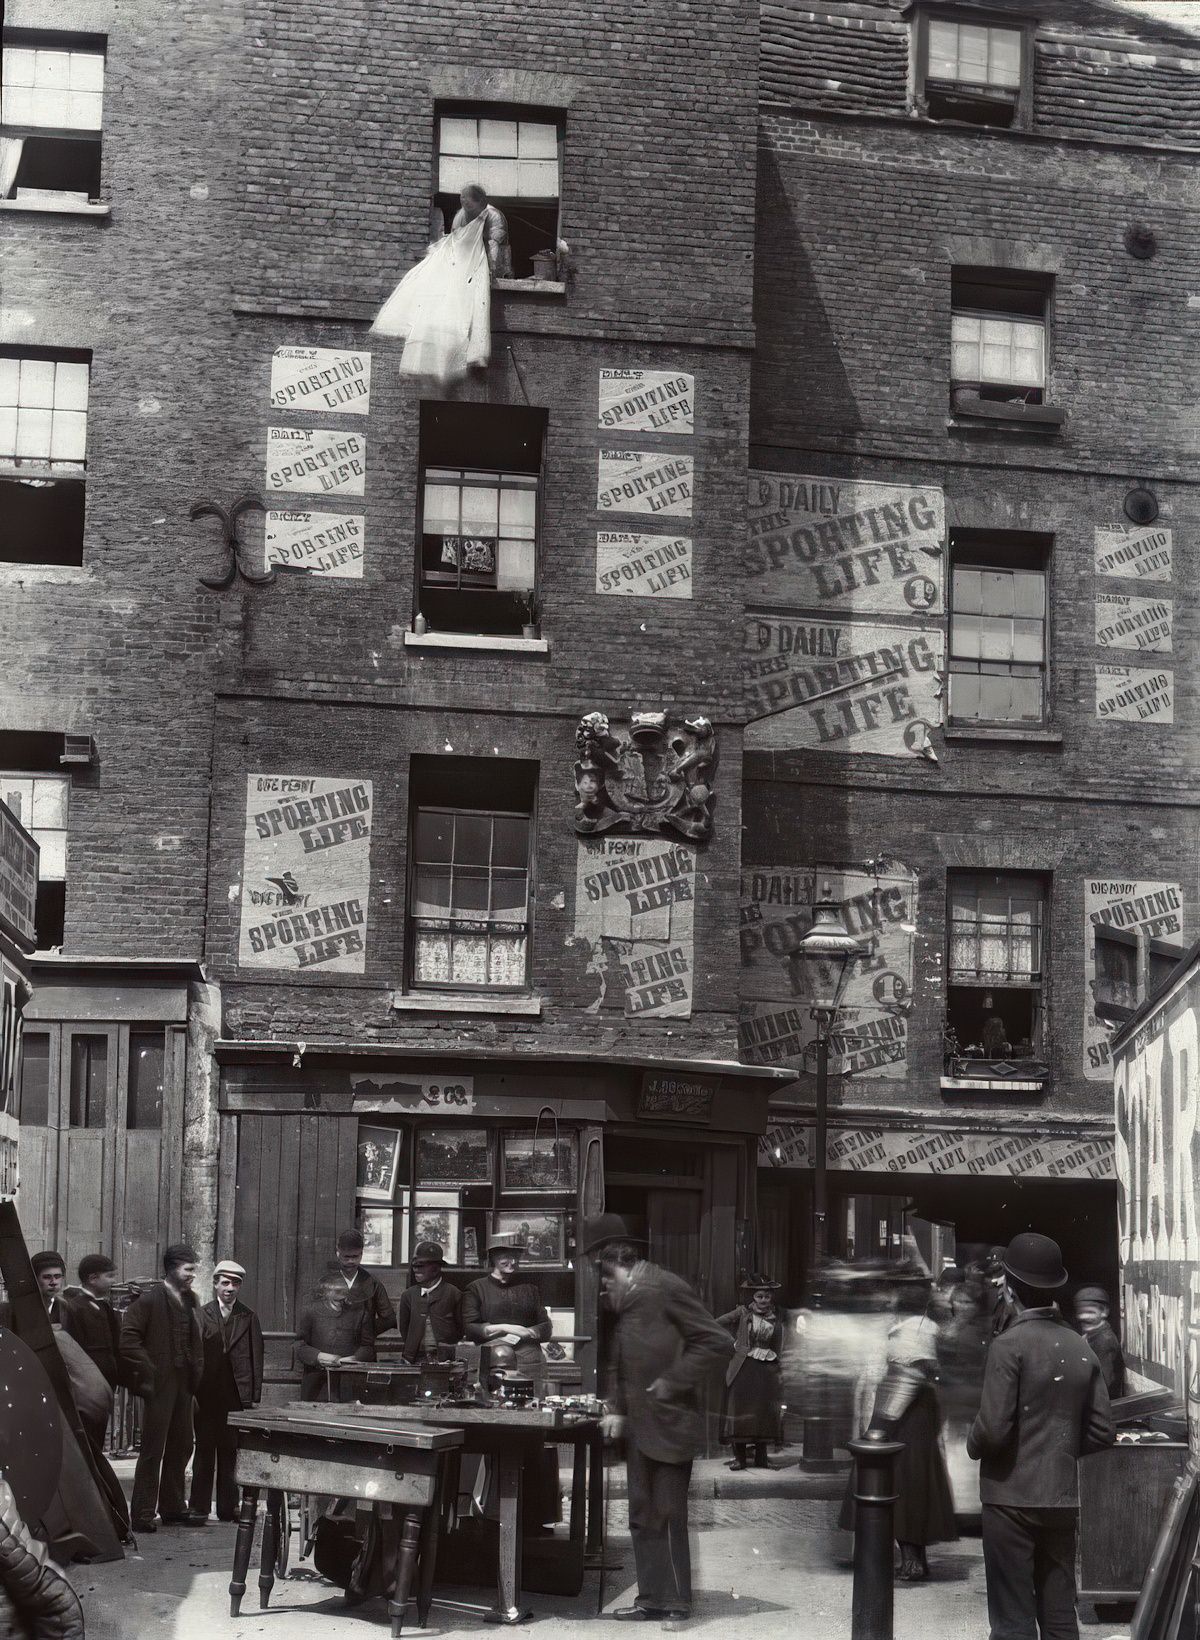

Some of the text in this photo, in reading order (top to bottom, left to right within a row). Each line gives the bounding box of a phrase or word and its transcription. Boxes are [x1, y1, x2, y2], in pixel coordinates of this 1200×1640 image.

[779, 481, 840, 514] DAILY
[742, 495, 936, 576] SPORTING
[809, 541, 918, 599] LIFE
[779, 624, 841, 657] DAILY
[741, 637, 936, 715] SPORTING
[809, 685, 917, 743] LIFE
[254, 784, 370, 839] SPORTING
[299, 815, 369, 854] LIFE
[584, 846, 693, 901] SPORTING
[625, 878, 693, 916] LIFE
[249, 899, 365, 953] SPORTING
[1089, 887, 1181, 927] SPORTING
[294, 930, 364, 968] LIFE
